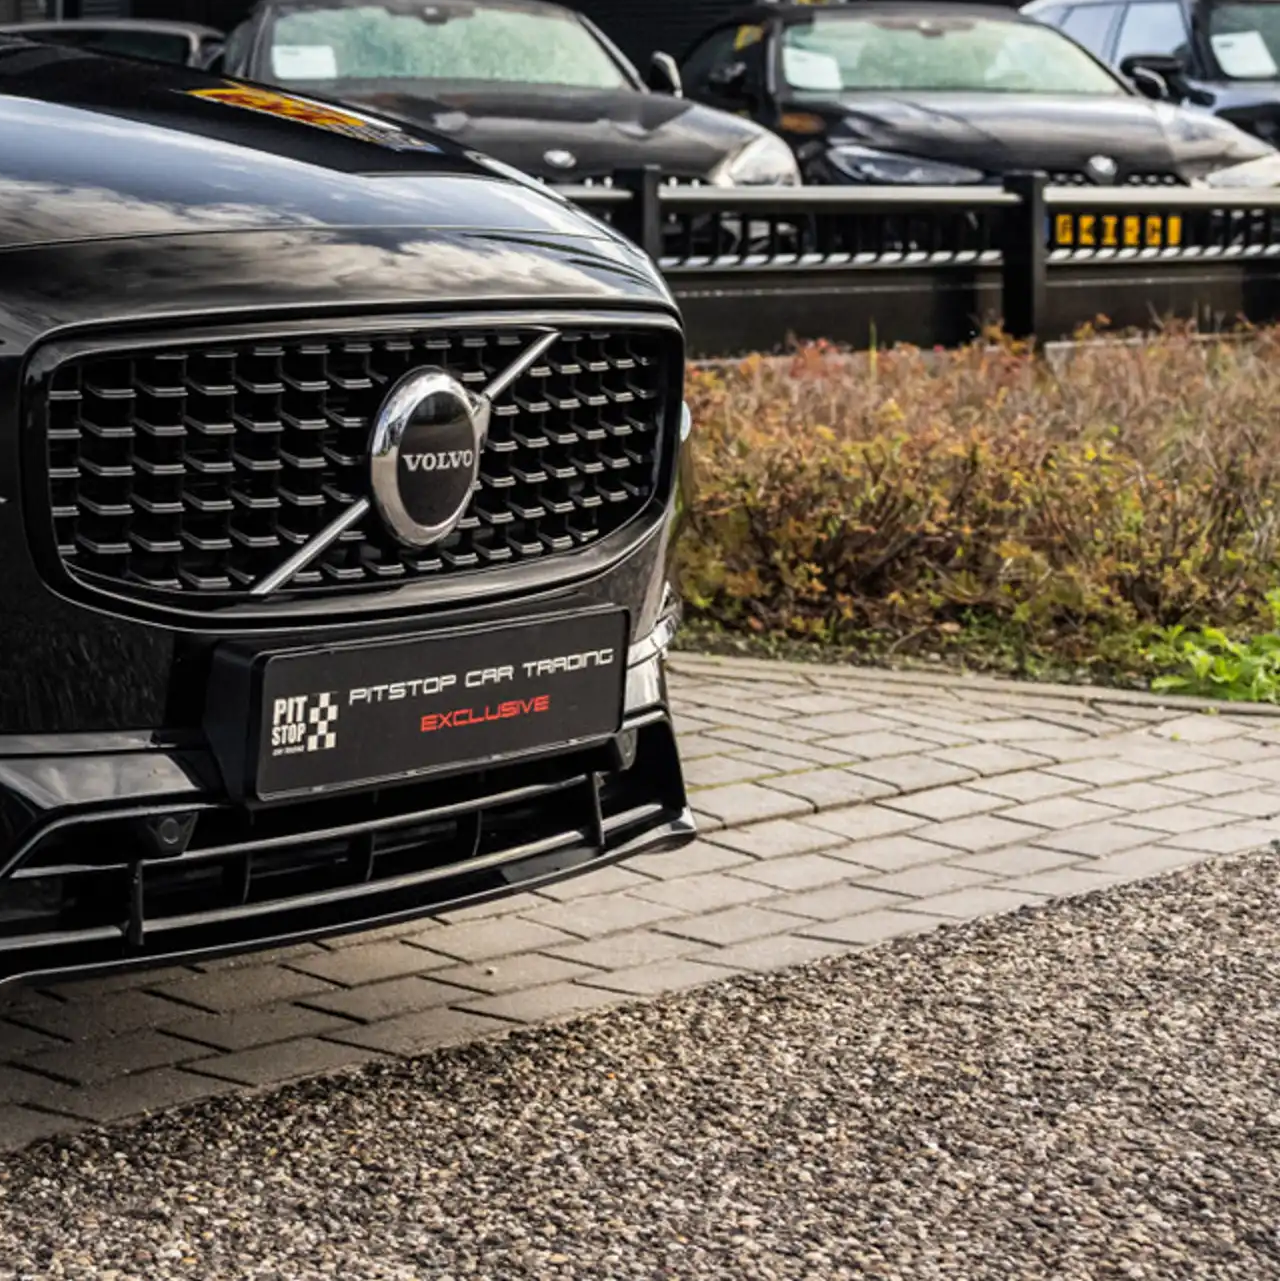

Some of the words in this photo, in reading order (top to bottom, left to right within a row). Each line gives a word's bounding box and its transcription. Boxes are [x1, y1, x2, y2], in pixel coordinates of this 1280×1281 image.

[402, 449, 474, 472] VOLVO
[348, 674, 457, 706] PITSTOP
[464, 665, 515, 689] CAR
[522, 647, 615, 679] TRADING
[272, 695, 309, 726] PIT
[419, 694, 551, 733] EXCLUSIVE
[271, 722, 307, 746] STOP
